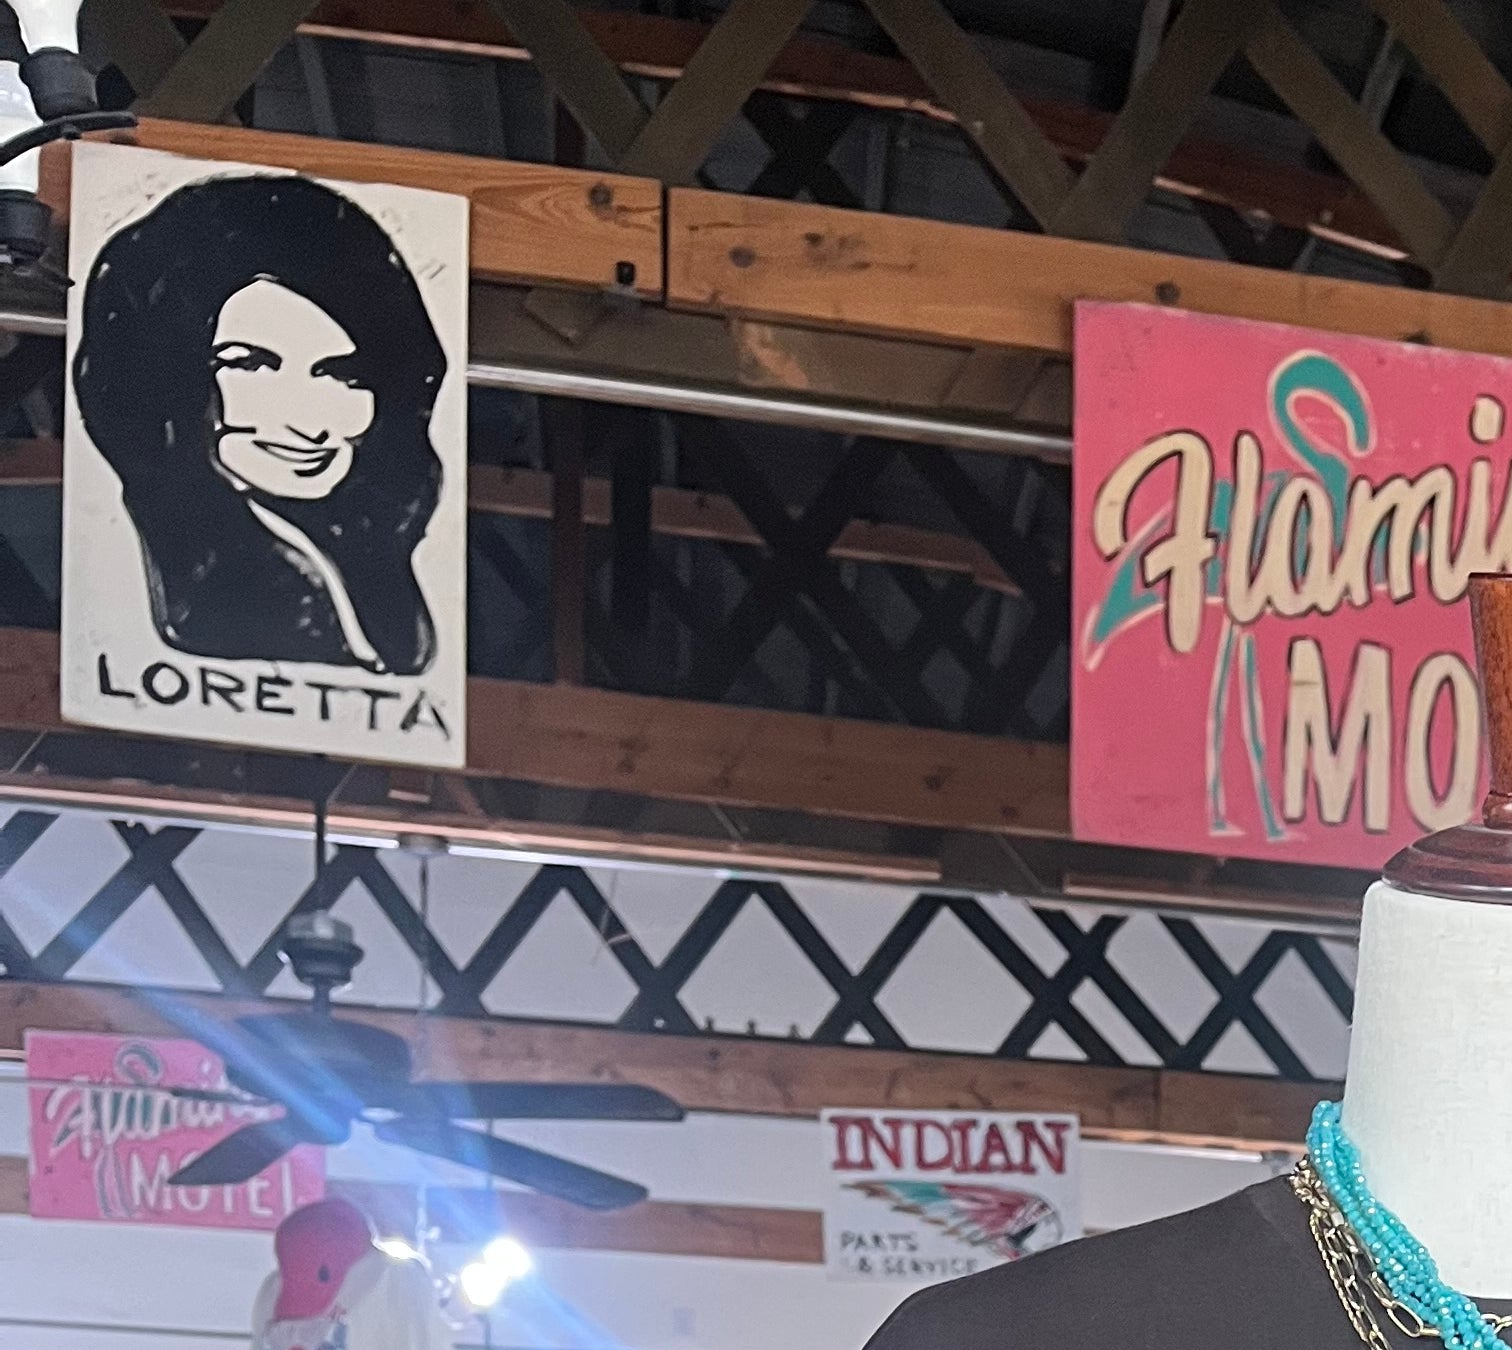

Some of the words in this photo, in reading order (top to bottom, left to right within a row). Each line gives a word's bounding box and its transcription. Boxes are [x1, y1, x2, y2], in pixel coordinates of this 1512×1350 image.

[98, 652, 451, 742] LORETTA
[828, 1116, 1072, 1175] INDIAN
[840, 1231, 918, 1252] PARTS
